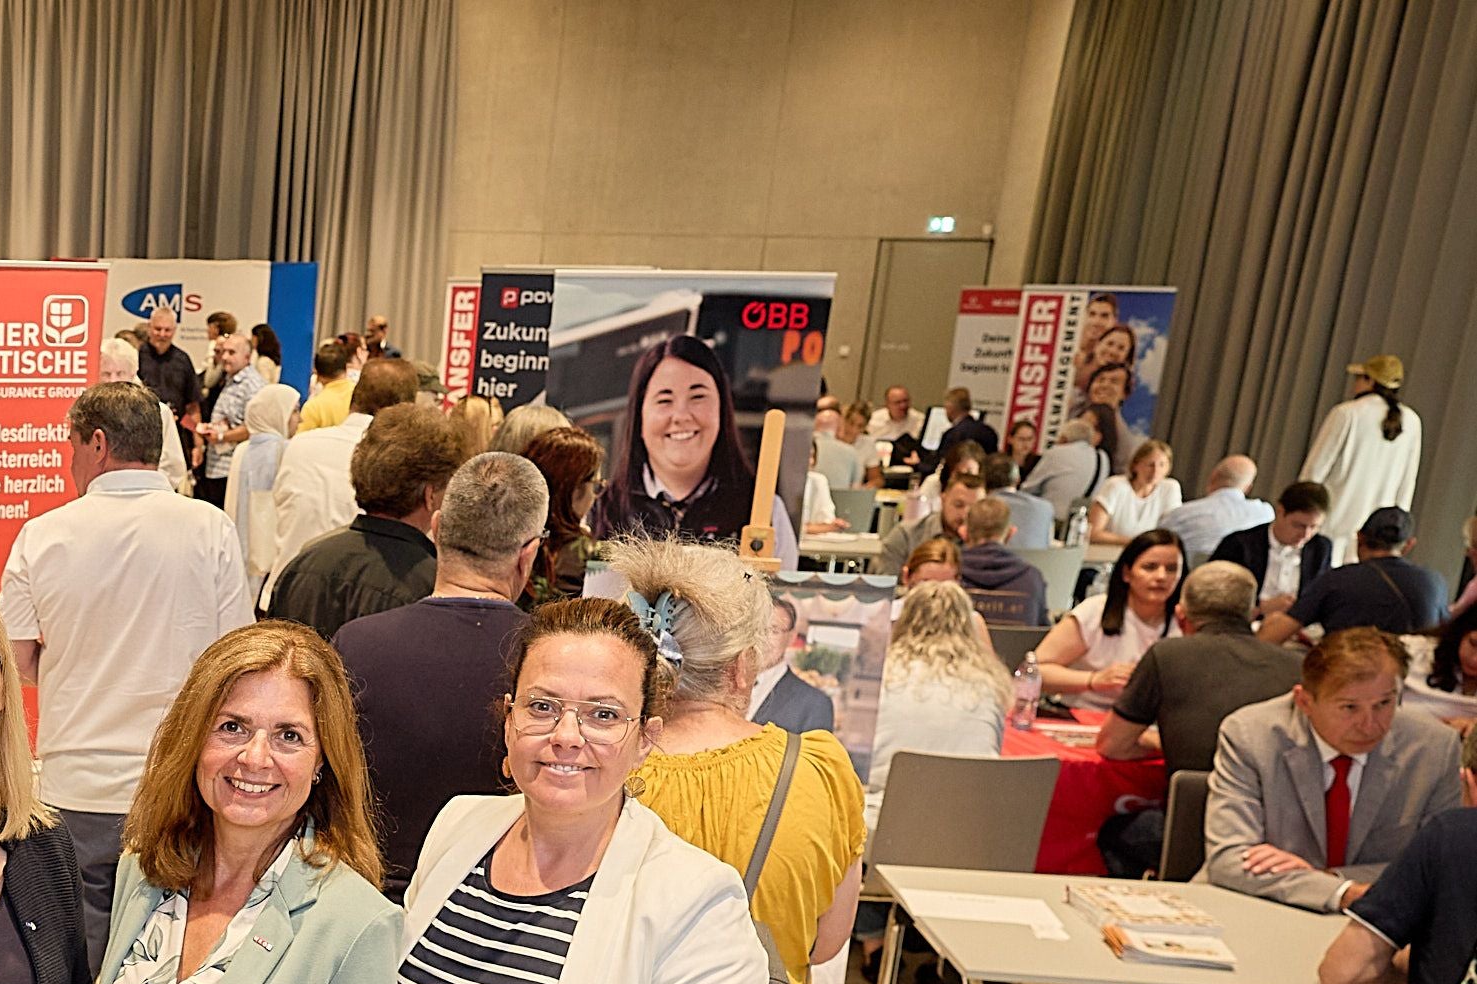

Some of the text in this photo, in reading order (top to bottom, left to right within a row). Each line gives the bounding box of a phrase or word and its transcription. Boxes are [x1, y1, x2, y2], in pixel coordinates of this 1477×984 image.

[139, 292, 202, 313] AMS
[741, 301, 811, 330] ÖBB
[483, 321, 550, 342] Zukun
[480, 349, 550, 374] beginn
[477, 377, 518, 398] hier
[4, 474, 65, 494] herzlich
